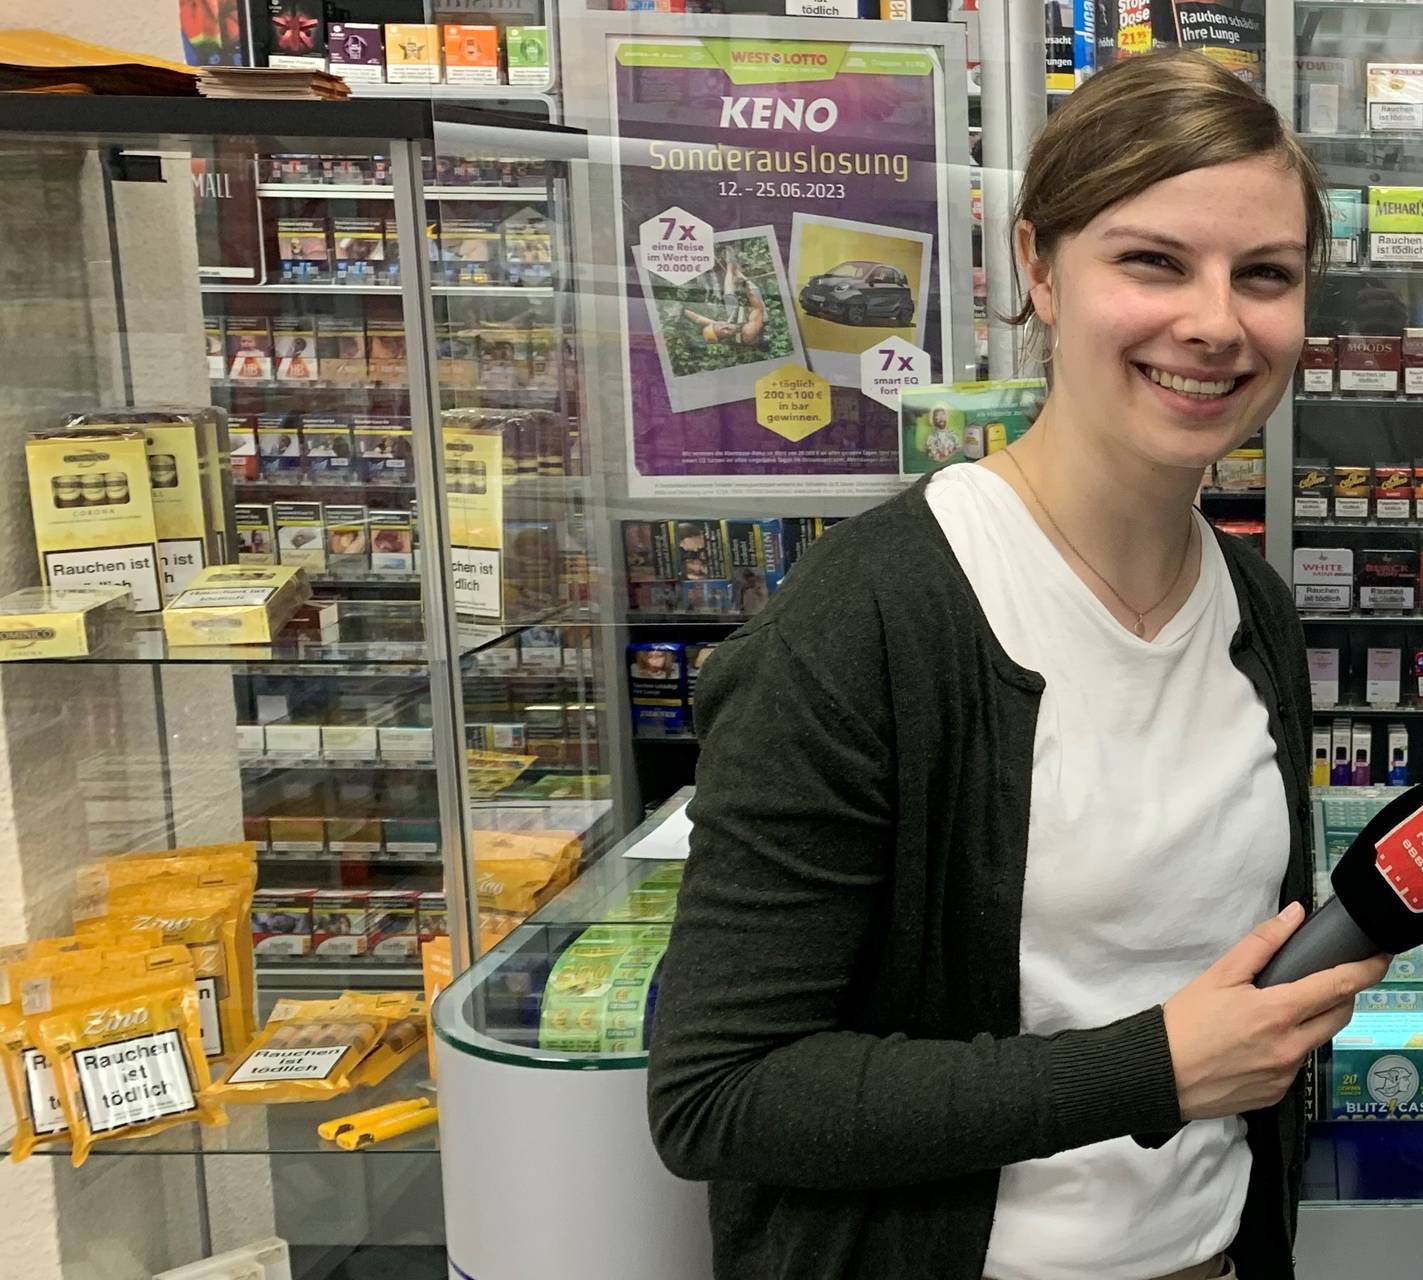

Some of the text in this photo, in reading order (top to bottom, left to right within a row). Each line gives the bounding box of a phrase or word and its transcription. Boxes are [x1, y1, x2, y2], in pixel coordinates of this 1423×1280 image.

[801, 4, 840, 16] tödlich
[1120, 8, 1150, 27] Dose
[1180, 11, 1228, 25] Rauchen
[1183, 27, 1240, 44] Ihre Lunge
[731, 51, 828, 66] WEST LOTTO
[719, 97, 839, 133] KENO
[650, 142, 909, 182] Sonderauslosung
[192, 173, 232, 198] MALL
[658, 218, 697, 241] 7x
[1378, 235, 1422, 245] Rauchen
[652, 242, 704, 252] eine Reise
[1377, 246, 1390, 254] ist
[648, 253, 710, 263] im Wert von
[1347, 343, 1392, 353] MOODS
[878, 350, 914, 371] 7x
[780, 379, 815, 391] täglich
[874, 377, 919, 387] smart EQ
[764, 391, 784, 400] 200
[794, 391, 814, 400] 100
[779, 402, 809, 411] in bar
[767, 413, 822, 424] gewinnen.
[174, 553, 194, 566] ist
[53, 558, 151, 576] Rauchen ist
[479, 562, 494, 575] ist
[1303, 563, 1345, 571] WHITE
[83, 1041, 176, 1071] Rauchen
[252, 1047, 342, 1059] Rauchen
[279, 1057, 303, 1066] ist
[121, 1063, 149, 1084] ist
[250, 1063, 319, 1075] tödlich
[1343, 1073, 1358, 1085] 20
[1346, 1101, 1388, 1113] BLITZ
